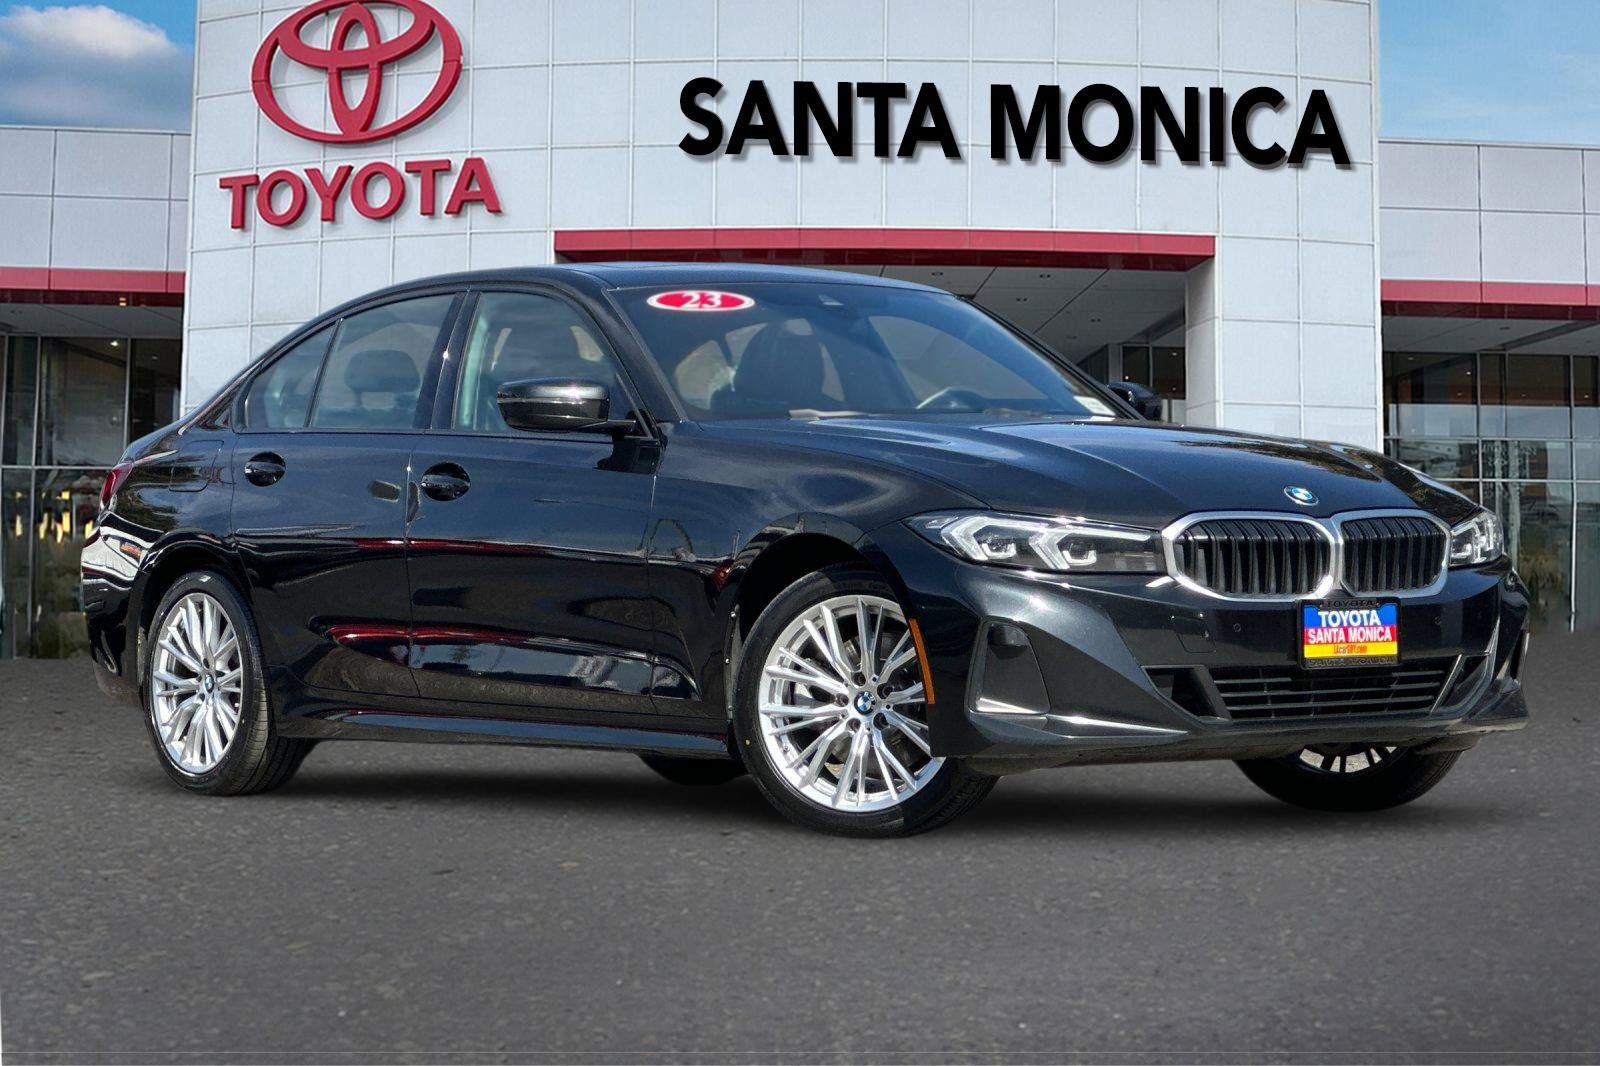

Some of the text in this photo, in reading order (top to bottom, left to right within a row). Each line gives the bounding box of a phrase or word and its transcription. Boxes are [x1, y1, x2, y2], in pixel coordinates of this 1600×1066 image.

[679, 78, 1351, 166] SANTA MONICA
[220, 157, 502, 229] TOYOTA
[681, 292, 721, 309] 23
[1318, 610, 1381, 627] TOYOTA
[1308, 626, 1392, 644] SANTA MONICA
